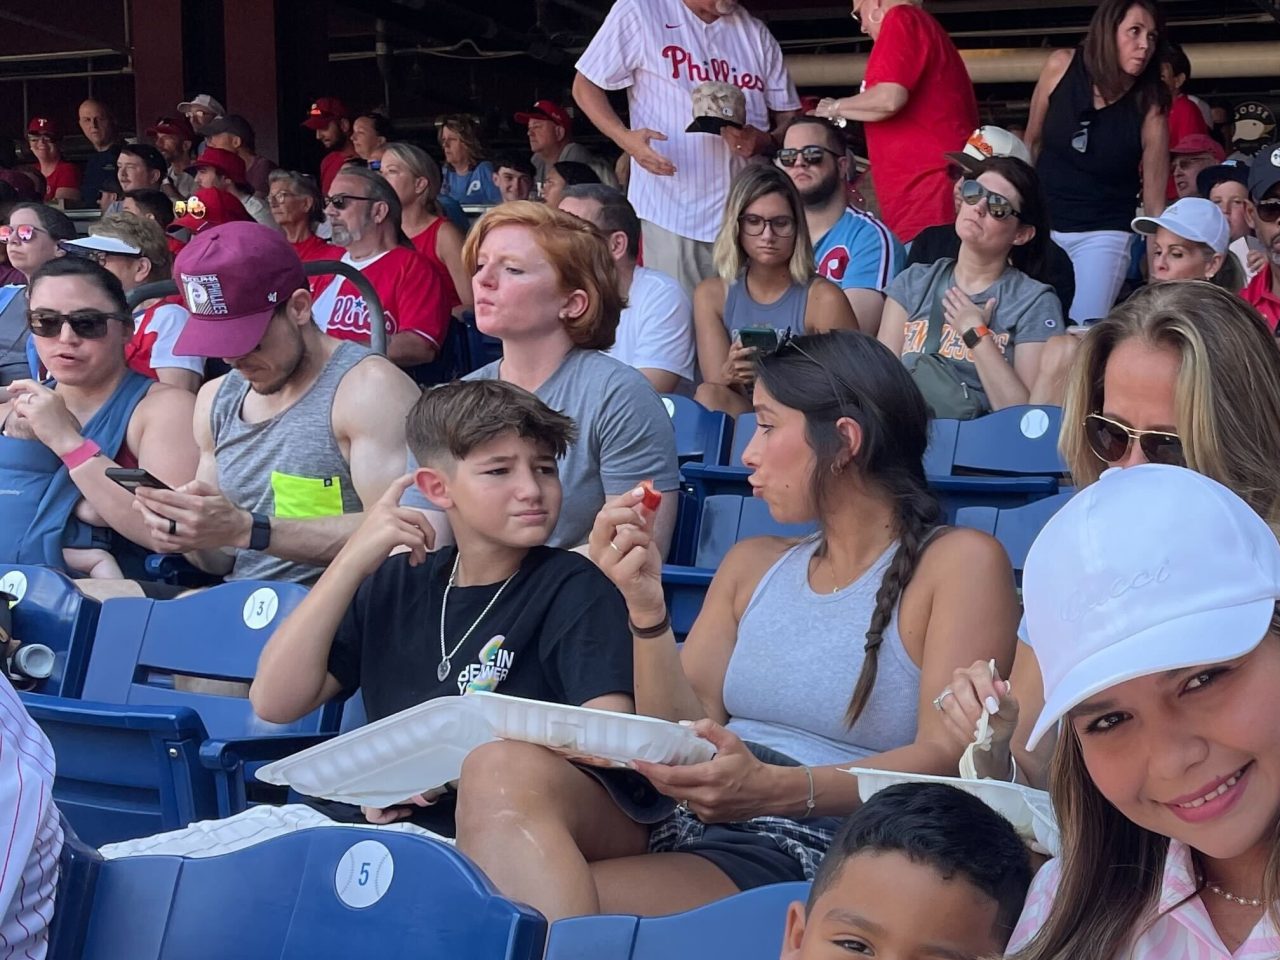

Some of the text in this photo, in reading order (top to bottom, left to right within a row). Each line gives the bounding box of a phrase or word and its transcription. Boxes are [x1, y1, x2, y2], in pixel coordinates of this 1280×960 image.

[662, 45, 765, 92] Phillies
[256, 601, 264, 617] 3
[358, 862, 371, 887] 5
